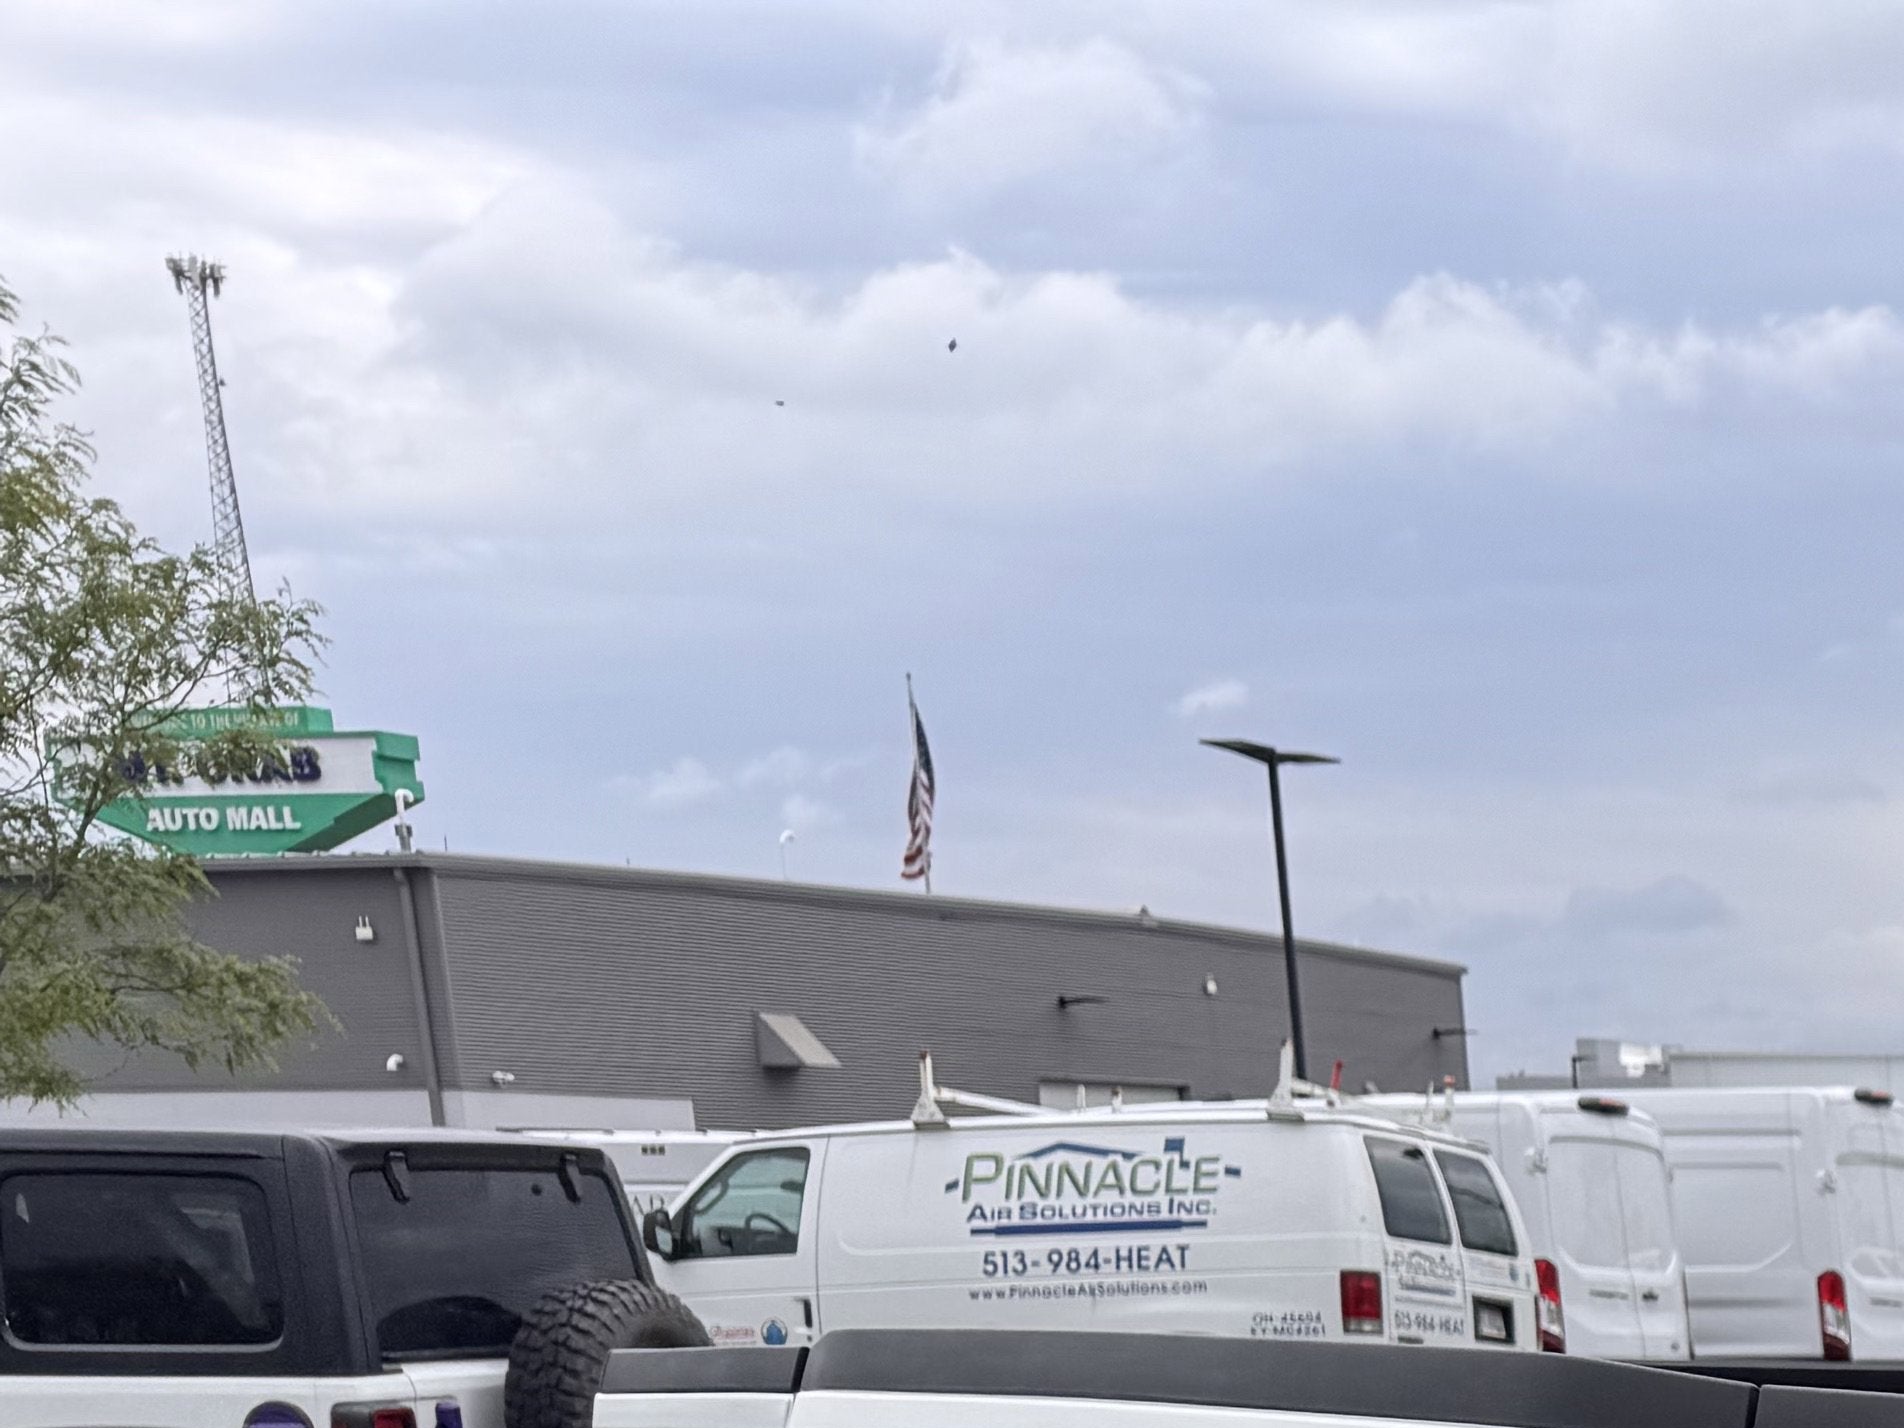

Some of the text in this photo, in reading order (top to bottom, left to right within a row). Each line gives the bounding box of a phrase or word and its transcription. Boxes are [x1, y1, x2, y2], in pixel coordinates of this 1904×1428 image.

[147, 806, 302, 832] AUTO MALL
[962, 1153, 1221, 1203] PINNACLE
[967, 1197, 1217, 1223] AIR SOLUTIONS INC.
